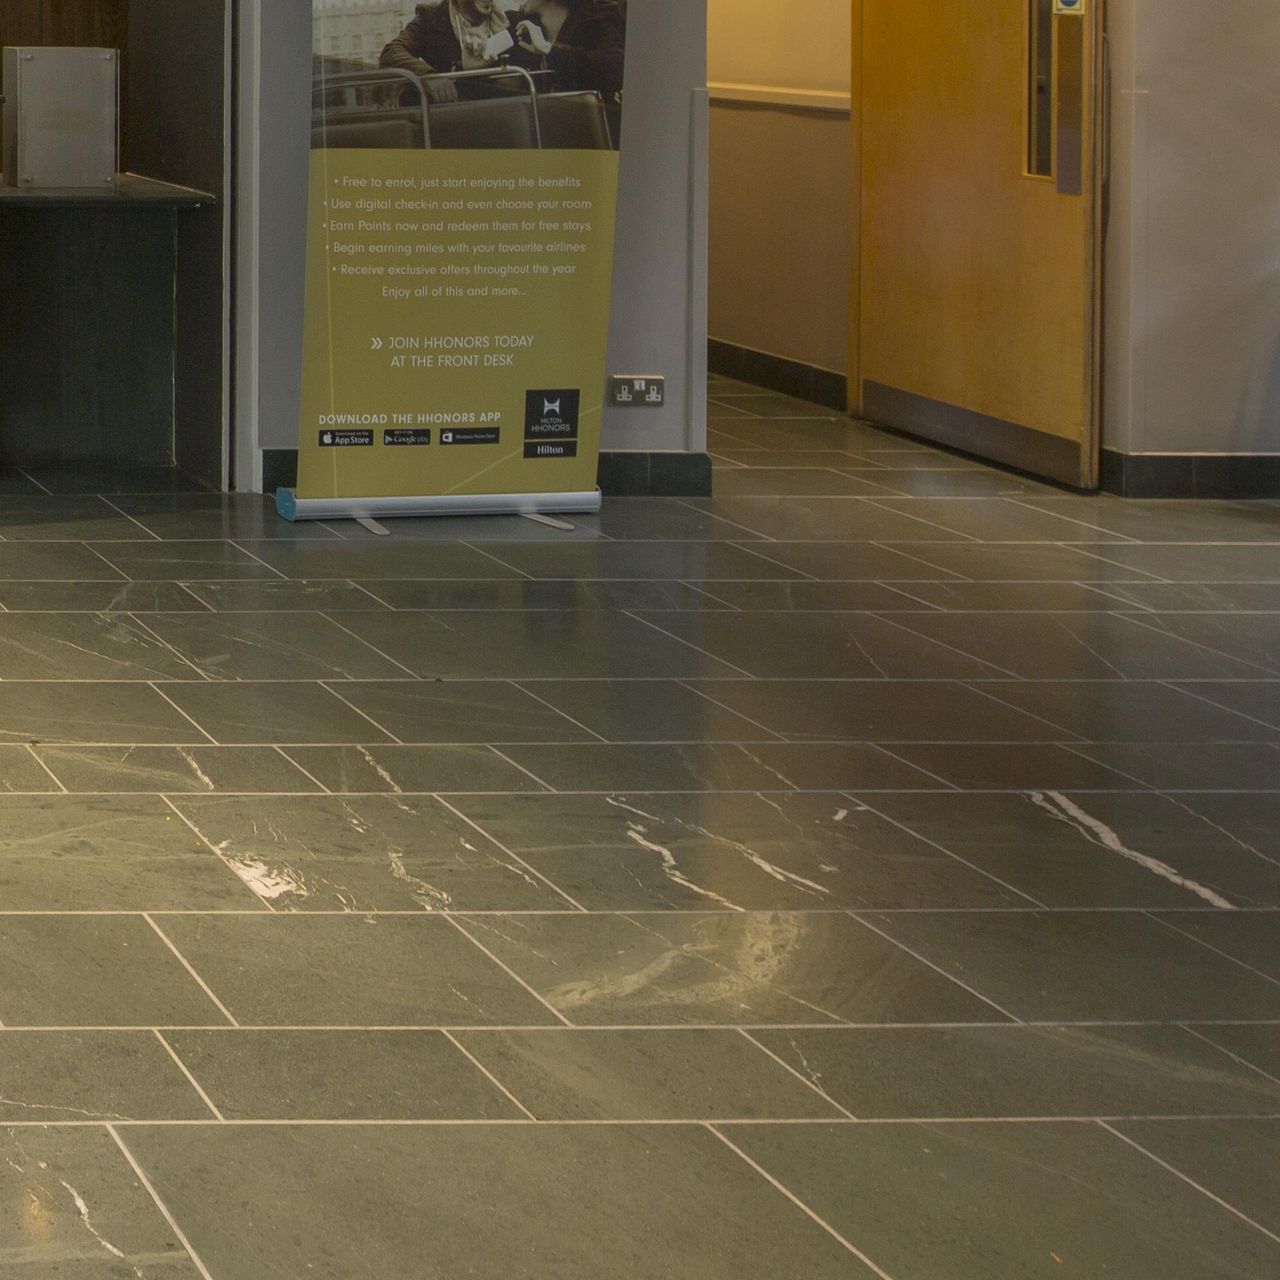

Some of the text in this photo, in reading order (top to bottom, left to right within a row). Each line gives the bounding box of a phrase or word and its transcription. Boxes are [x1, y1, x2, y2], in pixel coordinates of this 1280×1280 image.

[342, 177, 581, 190] Free to enrol, just start enjoying the benefits
[331, 199, 352, 209] Use
[355, 199, 391, 212] digital
[395, 199, 438, 209] check-in
[442, 199, 463, 209] and
[496, 200, 534, 209] choose
[537, 201, 559, 211] your
[562, 201, 592, 209] room
[330, 220, 592, 233] Earn Points now and redeem them for free stays
[333, 242, 586, 256] Begin earning miles with your favourite airlines
[341, 264, 576, 277] Receive exclusive offers throughout the year
[382, 286, 527, 299] Enjoy all of this and more...
[388, 335, 535, 350] JOIN HHONORS TODAY
[390, 354, 514, 367] AT THE FRONT DESK
[318, 412, 501, 425] DOWNLOAD THE HHONORS APP
[335, 436, 370, 445] App Store
[537, 445, 563, 455] Hilton
